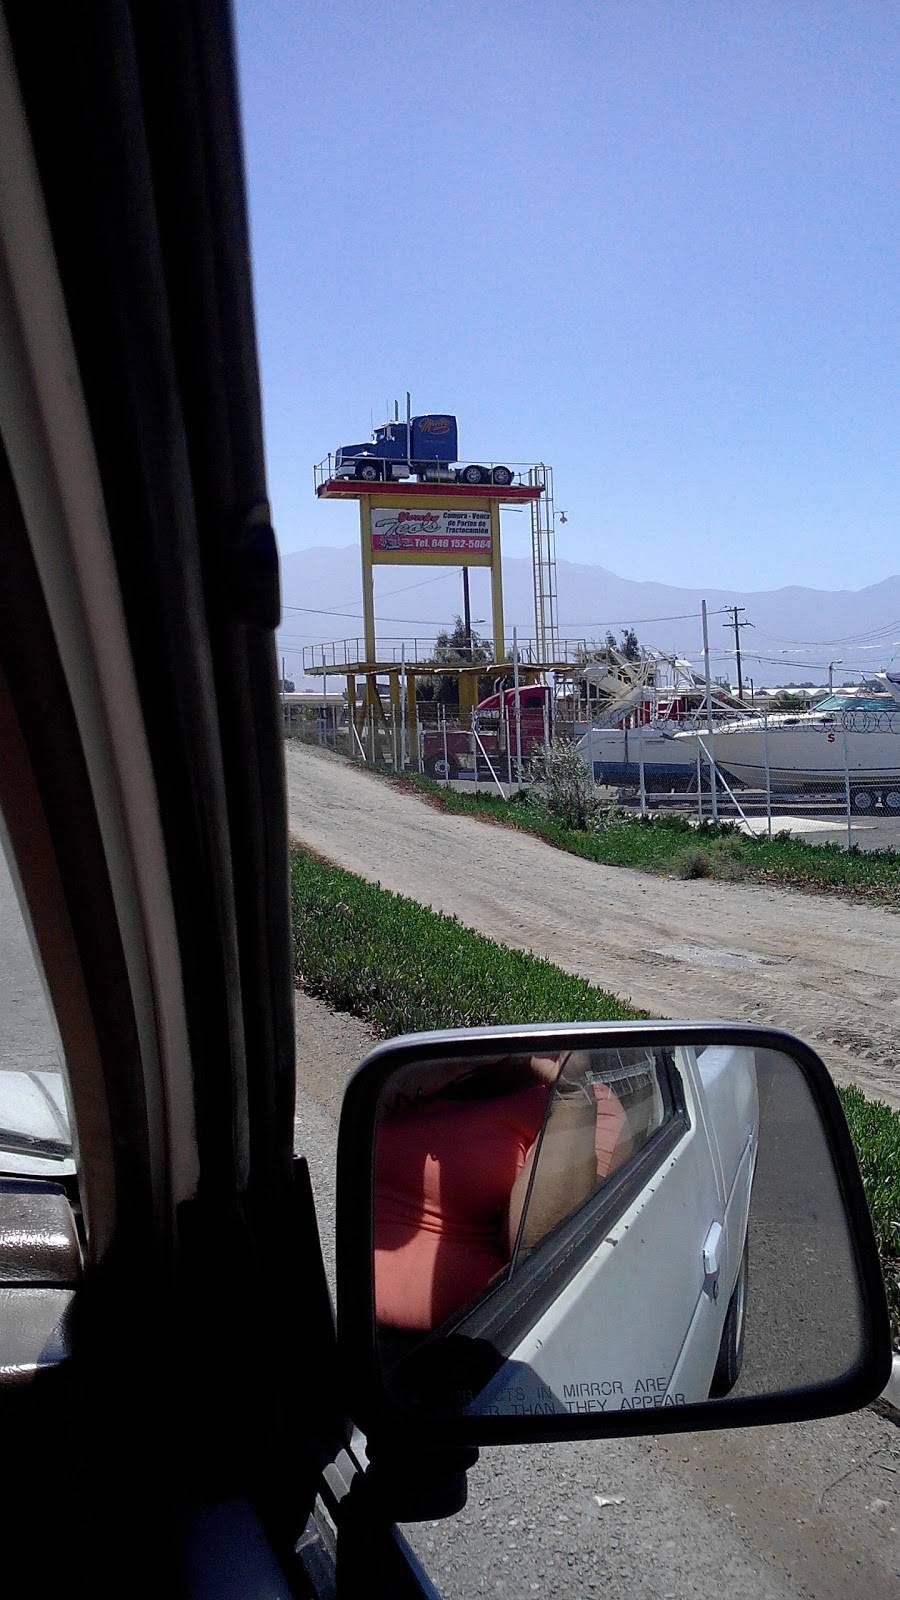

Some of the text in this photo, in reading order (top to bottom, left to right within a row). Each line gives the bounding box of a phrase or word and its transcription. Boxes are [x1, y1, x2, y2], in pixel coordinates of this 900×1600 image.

[537, 1385, 552, 1400] IN
[563, 1381, 624, 1399] MIRROR
[634, 1377, 668, 1393] ARE
[511, 1402, 556, 1415] THAN
